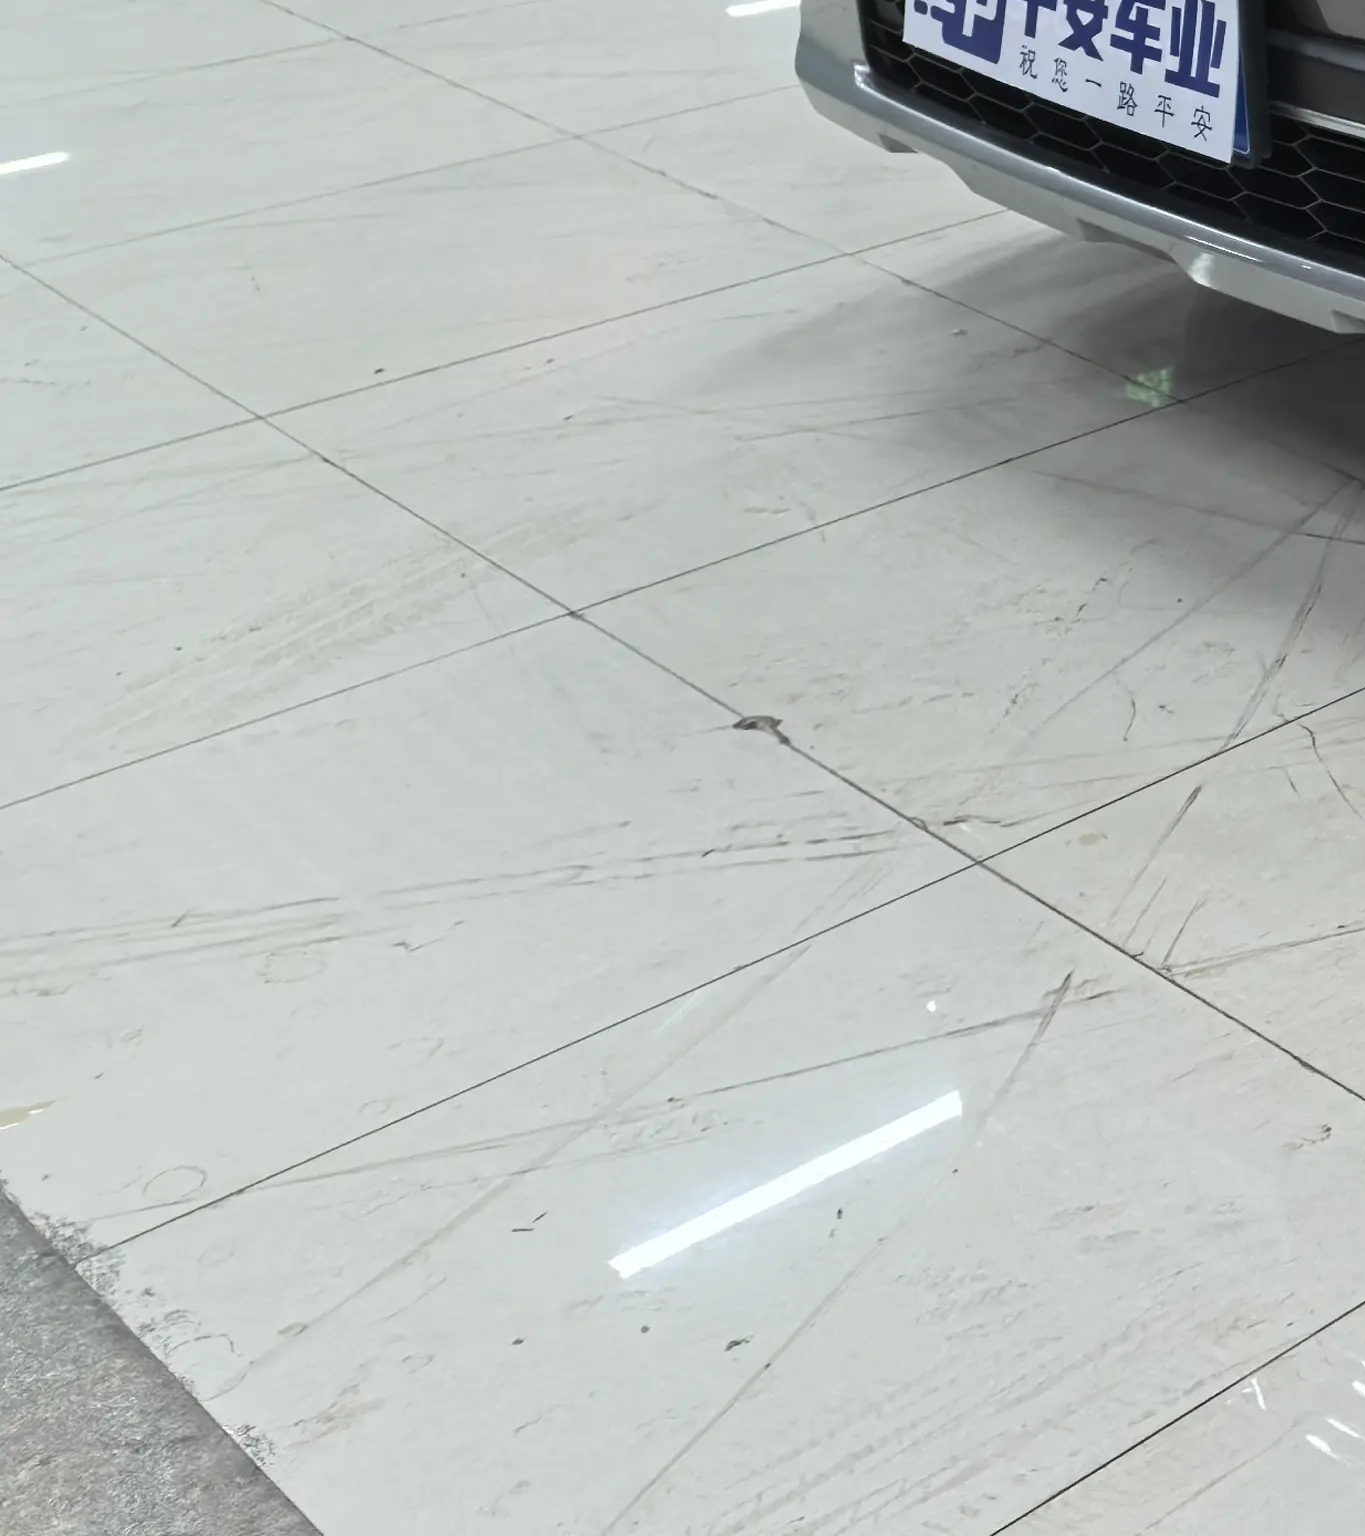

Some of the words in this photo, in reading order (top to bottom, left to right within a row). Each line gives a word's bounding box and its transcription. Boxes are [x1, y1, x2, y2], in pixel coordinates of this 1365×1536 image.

[1018, 45, 1214, 142] 祝您一路平安
